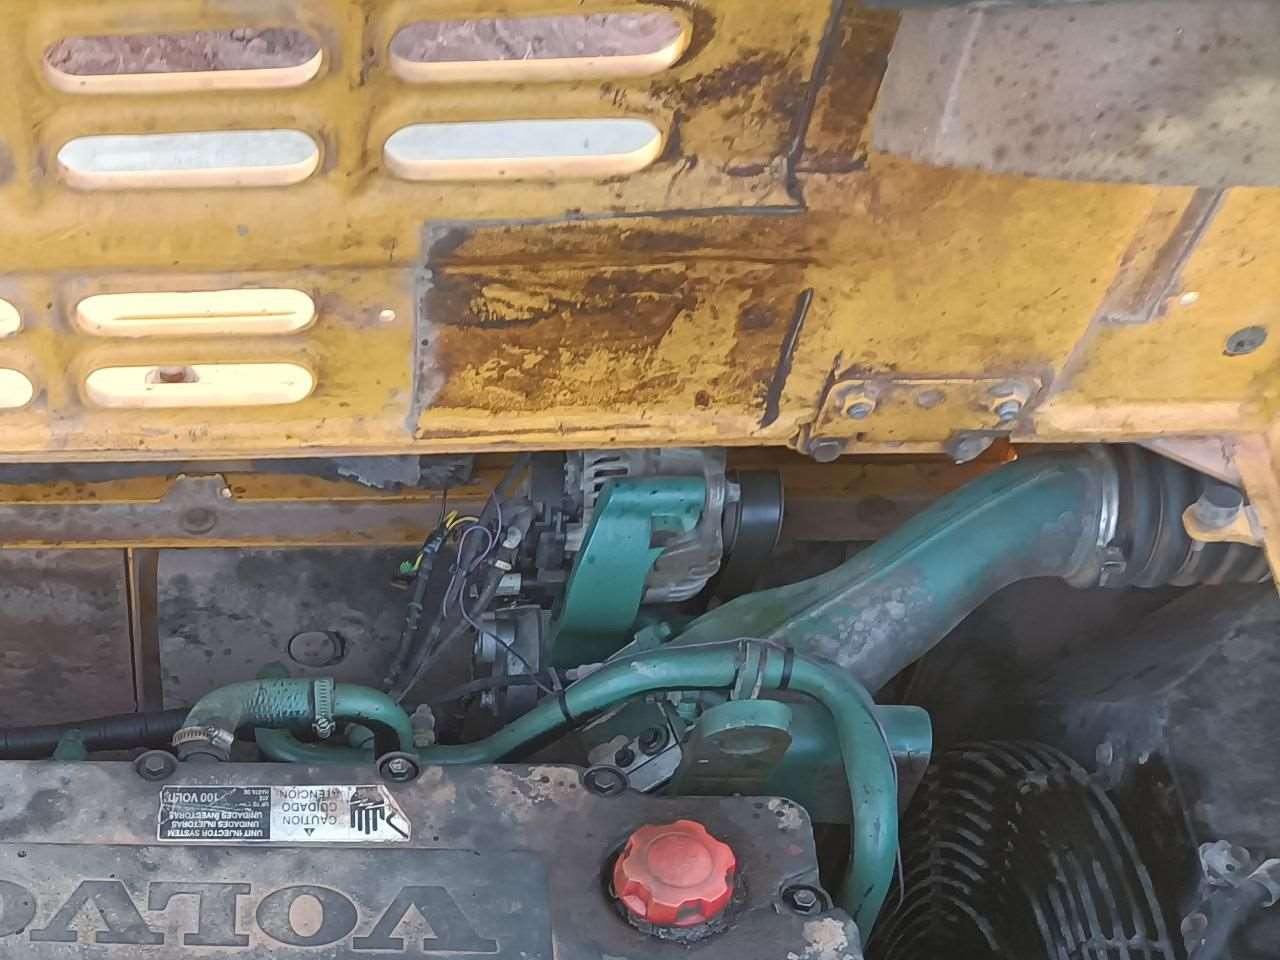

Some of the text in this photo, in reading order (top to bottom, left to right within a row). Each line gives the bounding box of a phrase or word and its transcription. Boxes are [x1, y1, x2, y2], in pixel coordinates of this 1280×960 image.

[200, 793, 219, 802] 100
[281, 802, 338, 812] CUIDADO
[221, 811, 263, 819] UNIDADES
[282, 815, 337, 825] CAUTION
[167, 829, 200, 837] SYSTEM
[202, 829, 242, 837] INJECTOR
